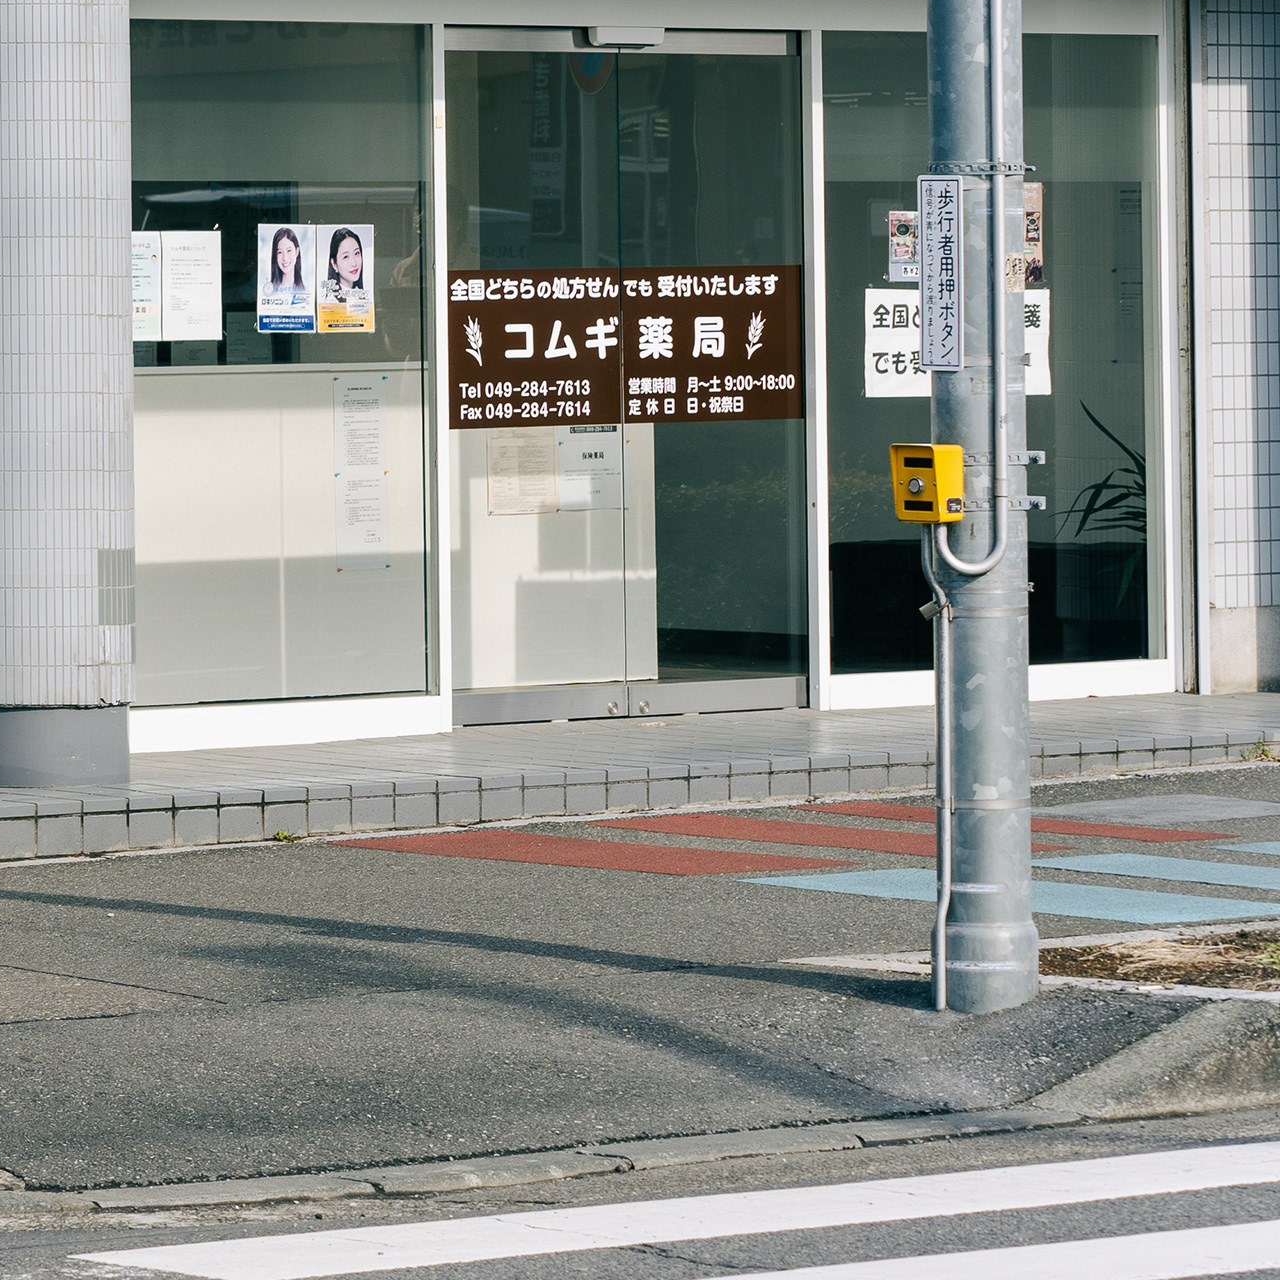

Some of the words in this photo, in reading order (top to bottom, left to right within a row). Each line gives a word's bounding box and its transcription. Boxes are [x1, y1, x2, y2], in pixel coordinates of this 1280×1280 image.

[925, 187, 934, 358] 信号が青になってから渡りましょう
[937, 187, 955, 359] 歩行者用押ボタン
[504, 315, 726, 360] コムギ薬局
[459, 382, 482, 399] Tel
[485, 379, 591, 398] 049-284-7613
[628, 377, 676, 395] 営業時間
[460, 404, 482, 420] Fax
[485, 400, 591, 418] 049-284-7614
[628, 397, 676, 416] 定休日
[686, 396, 744, 415] 日・祝祭日
